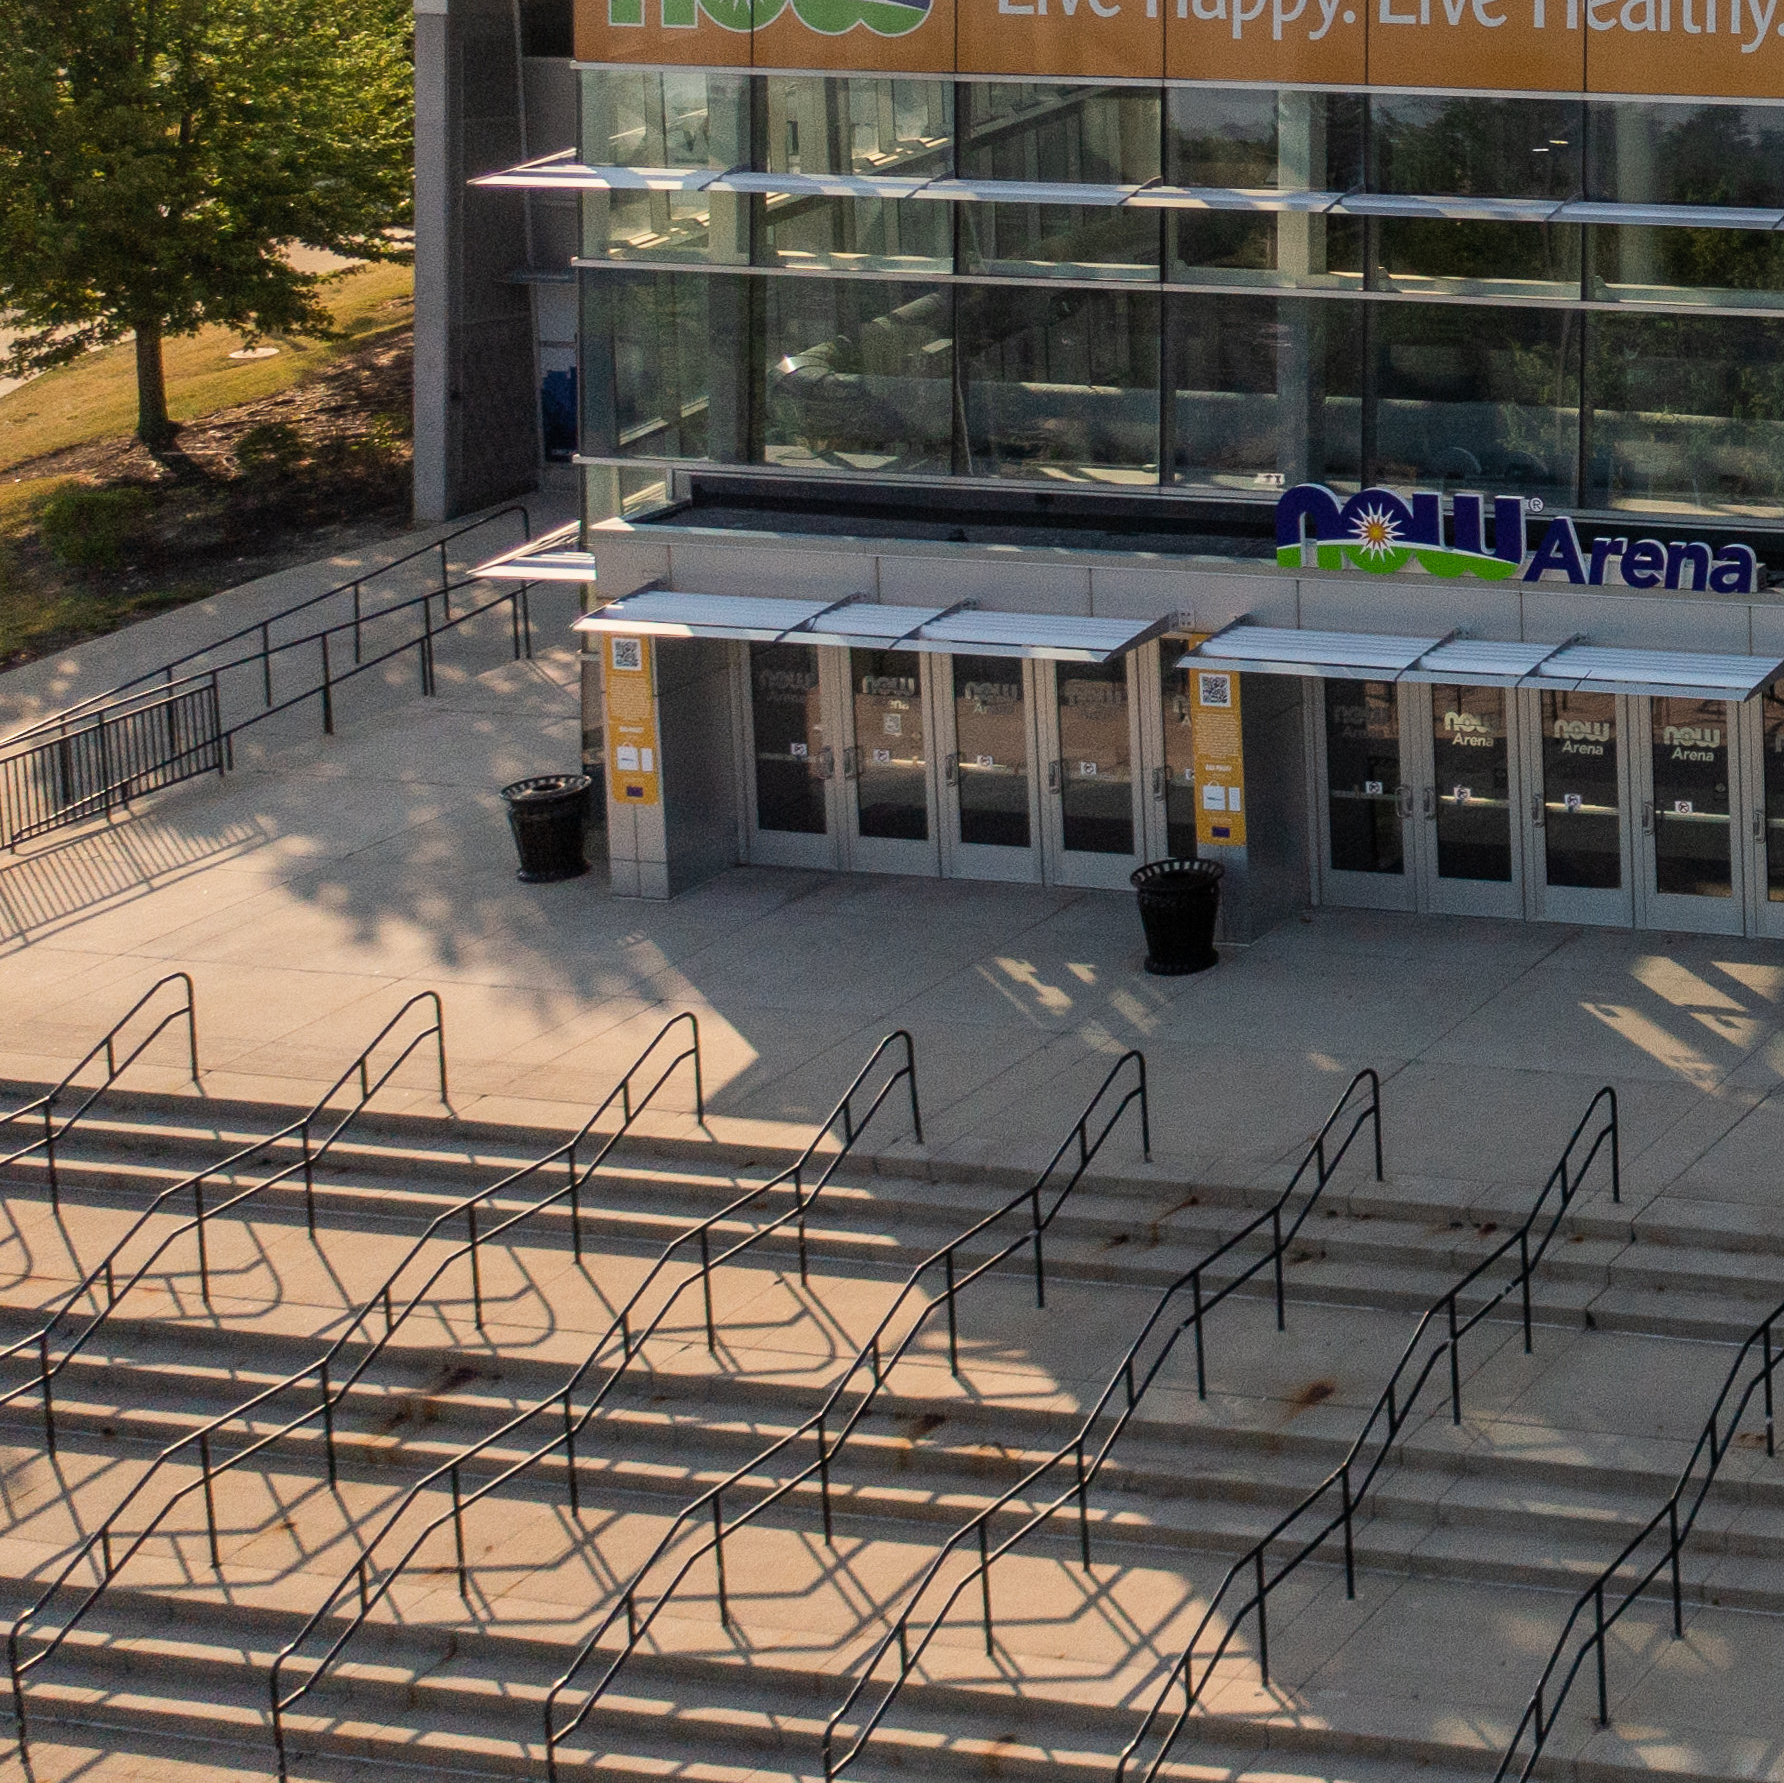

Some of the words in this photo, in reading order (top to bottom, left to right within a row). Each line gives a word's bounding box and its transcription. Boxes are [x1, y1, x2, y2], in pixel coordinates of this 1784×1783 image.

[1523, 515, 1758, 594] Arena
[1452, 734, 1494, 748] Arena
[1561, 740, 1604, 756] Arena
[1671, 747, 1714, 763] Arena
